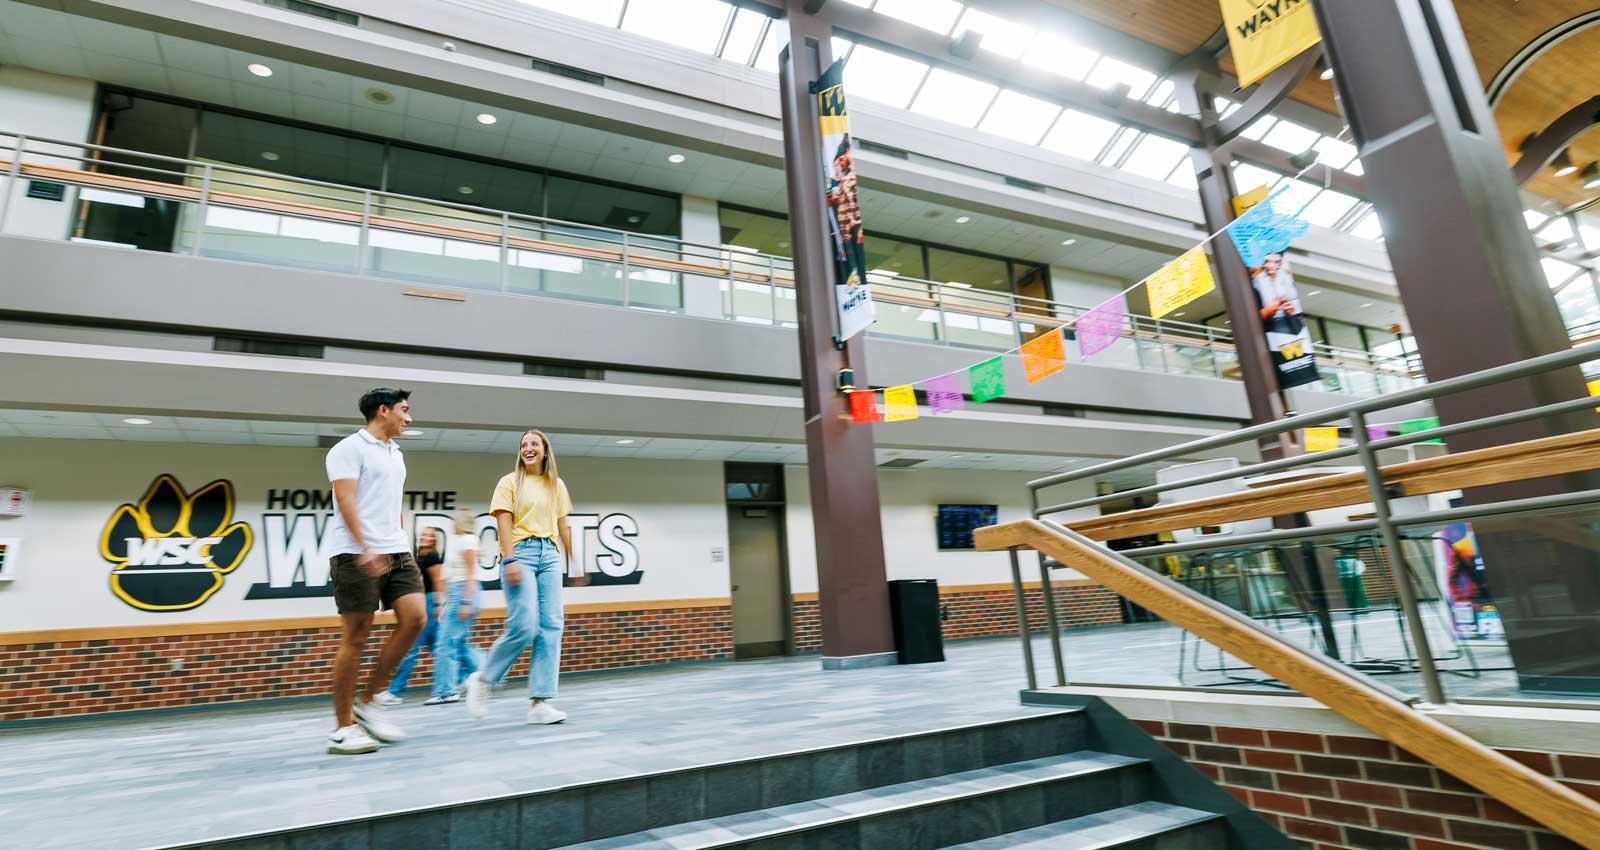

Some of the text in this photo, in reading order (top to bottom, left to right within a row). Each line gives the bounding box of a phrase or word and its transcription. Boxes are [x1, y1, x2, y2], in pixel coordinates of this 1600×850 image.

[267, 488, 457, 511] HOM THE
[124, 536, 224, 566] WSC
